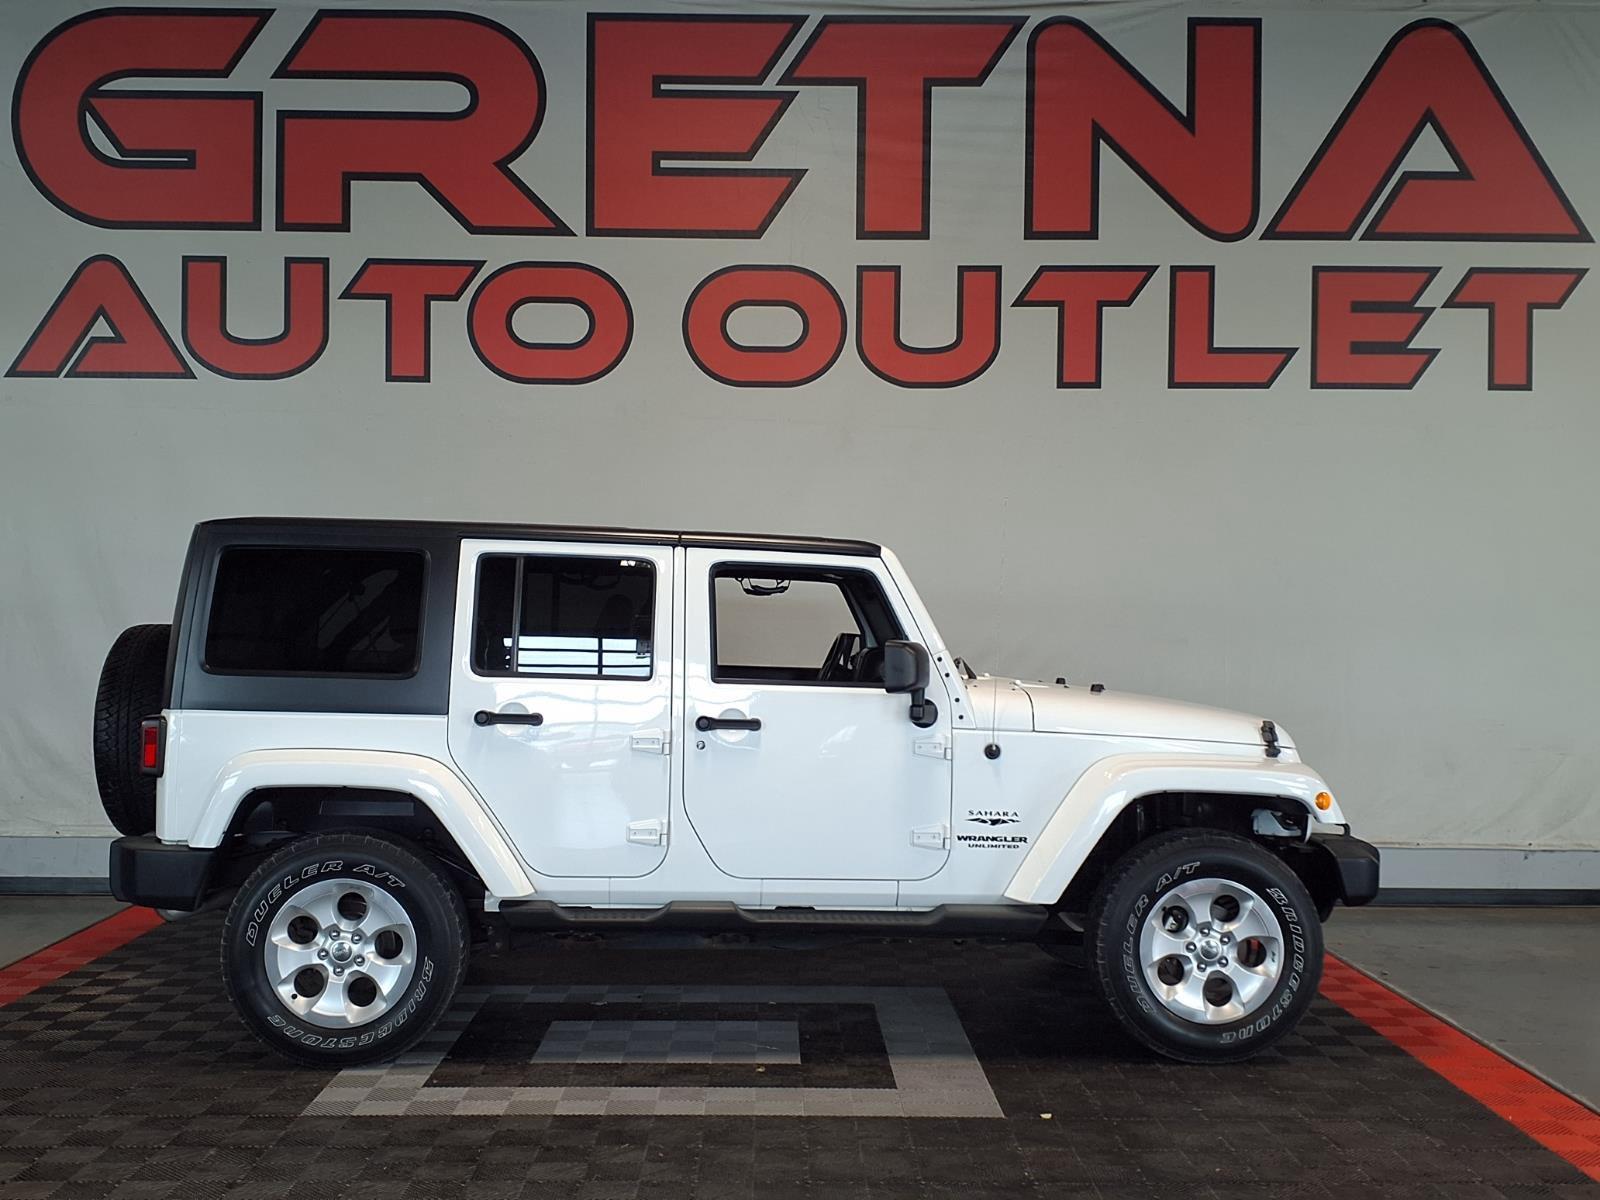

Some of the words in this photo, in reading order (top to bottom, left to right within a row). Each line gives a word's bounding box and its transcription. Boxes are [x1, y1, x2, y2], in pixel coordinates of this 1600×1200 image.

[12, 8, 1595, 243] GRETNA
[6, 255, 635, 386] AUTO
[683, 266, 1590, 392] OUTLET
[956, 834, 1028, 844] WRANGLER
[968, 809, 1019, 817] SAHARA
[245, 860, 344, 948] DUELER
[352, 863, 406, 889] A/T
[1122, 894, 1153, 1014] DUELER
[1155, 861, 1201, 893] A/T
[266, 956, 435, 1048] BRIDGESTONE
[1219, 887, 1305, 1044] BRIDGESTONE
